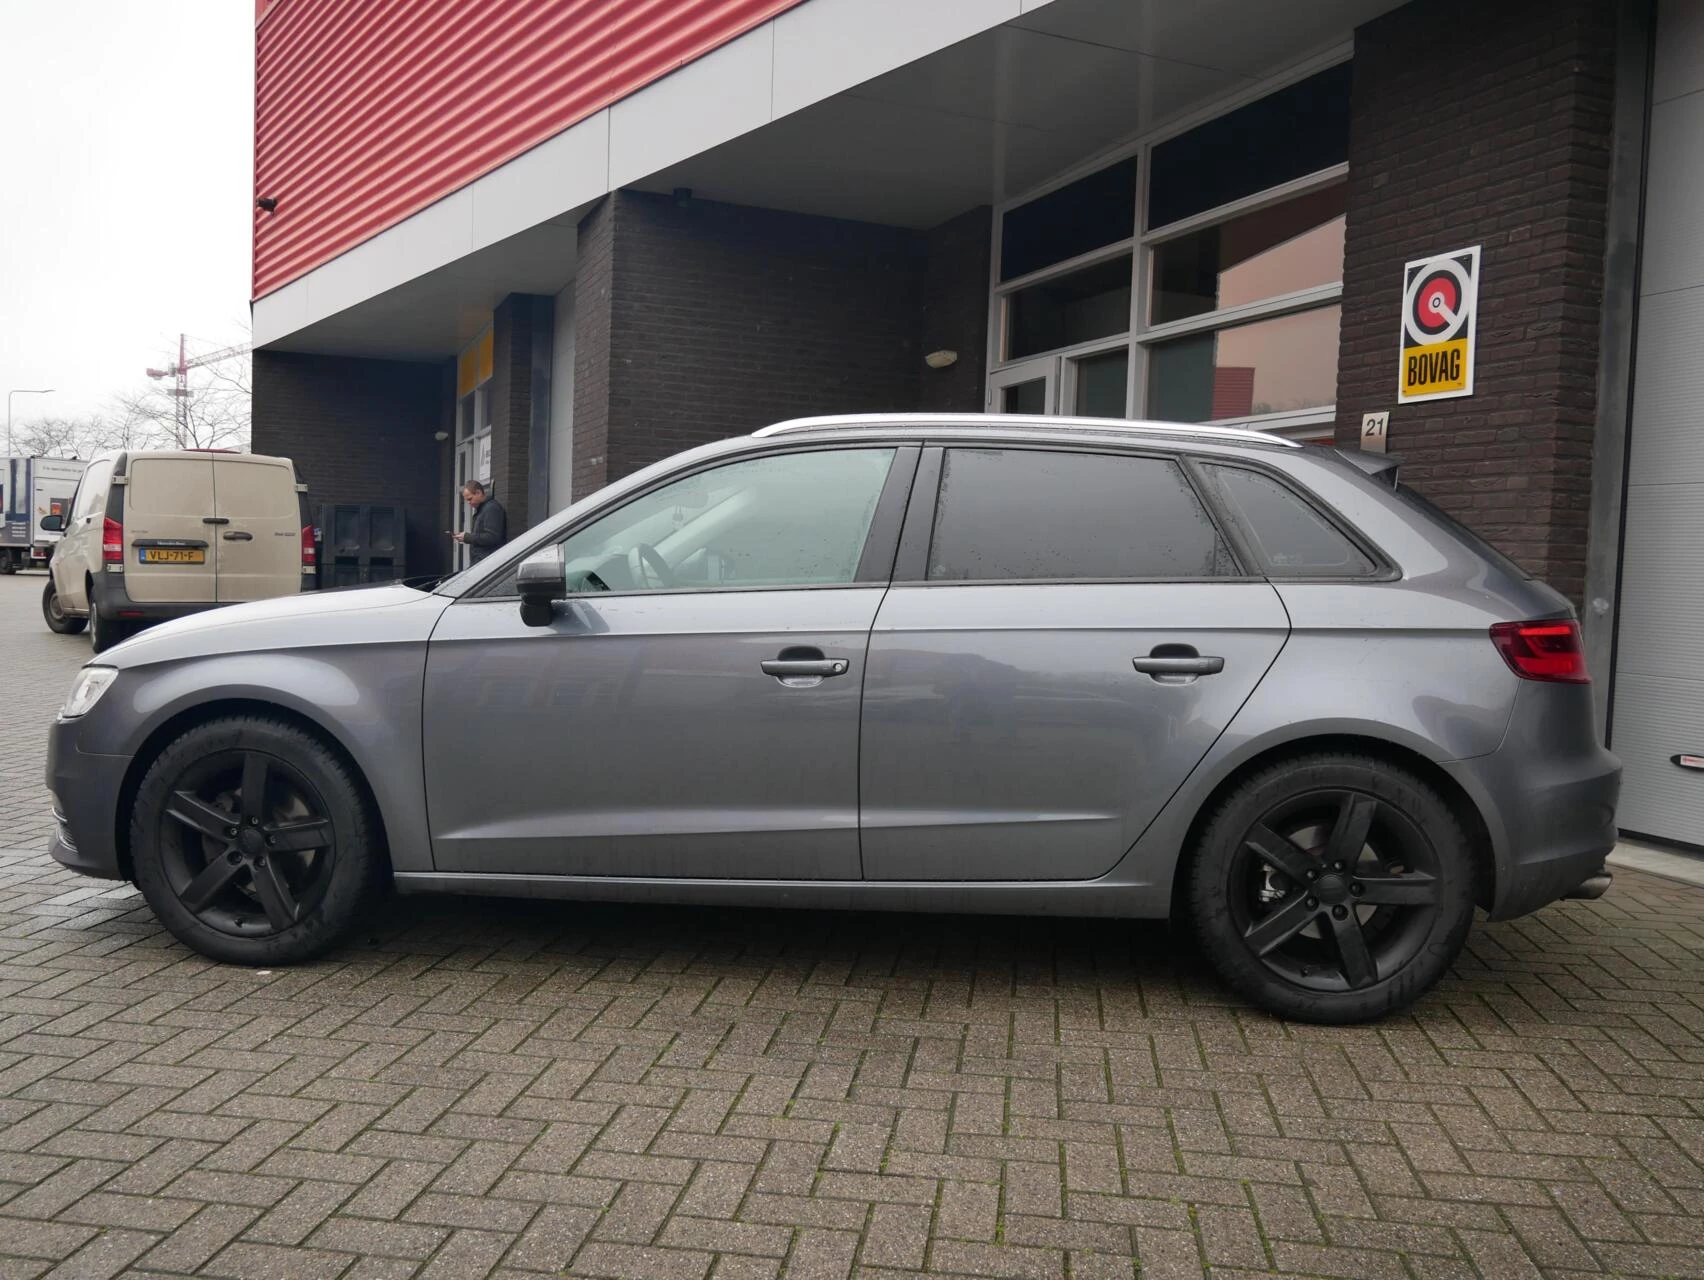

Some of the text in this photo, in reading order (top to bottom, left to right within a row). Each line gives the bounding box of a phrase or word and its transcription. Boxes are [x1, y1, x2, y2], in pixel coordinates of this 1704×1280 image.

[1407, 348, 1461, 387] BOVAG
[1365, 418, 1384, 437] 21
[149, 551, 194, 561] VLJ-71-F
